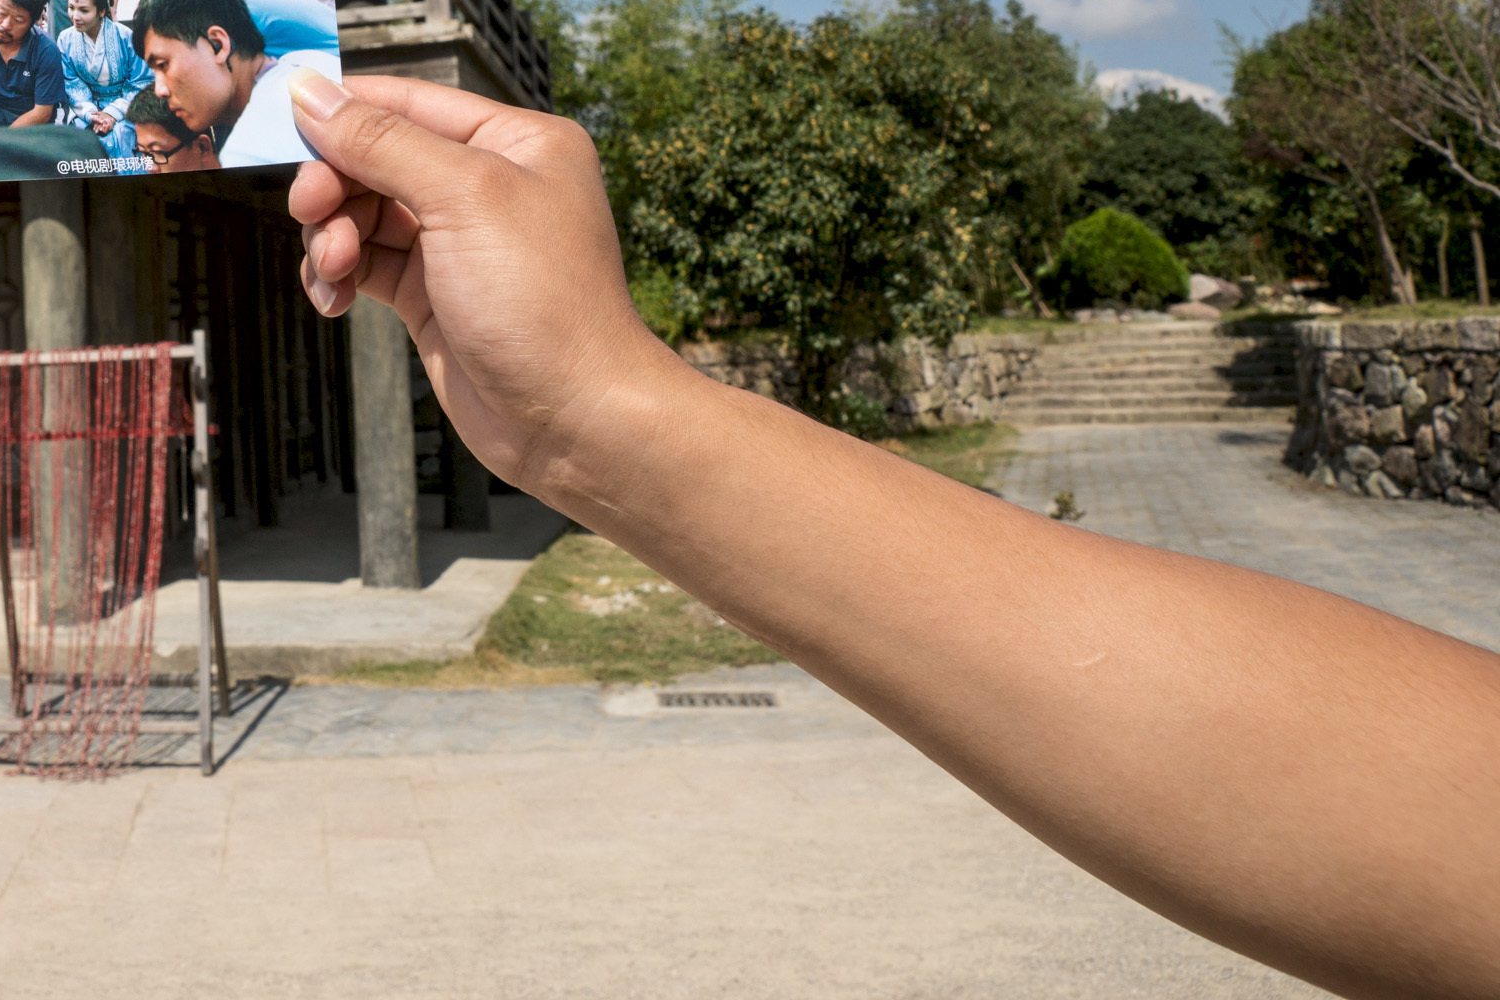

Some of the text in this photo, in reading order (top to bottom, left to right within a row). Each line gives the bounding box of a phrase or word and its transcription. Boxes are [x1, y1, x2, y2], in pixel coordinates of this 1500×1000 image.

[56, 155, 154, 175] @电视剧琅琊榜
